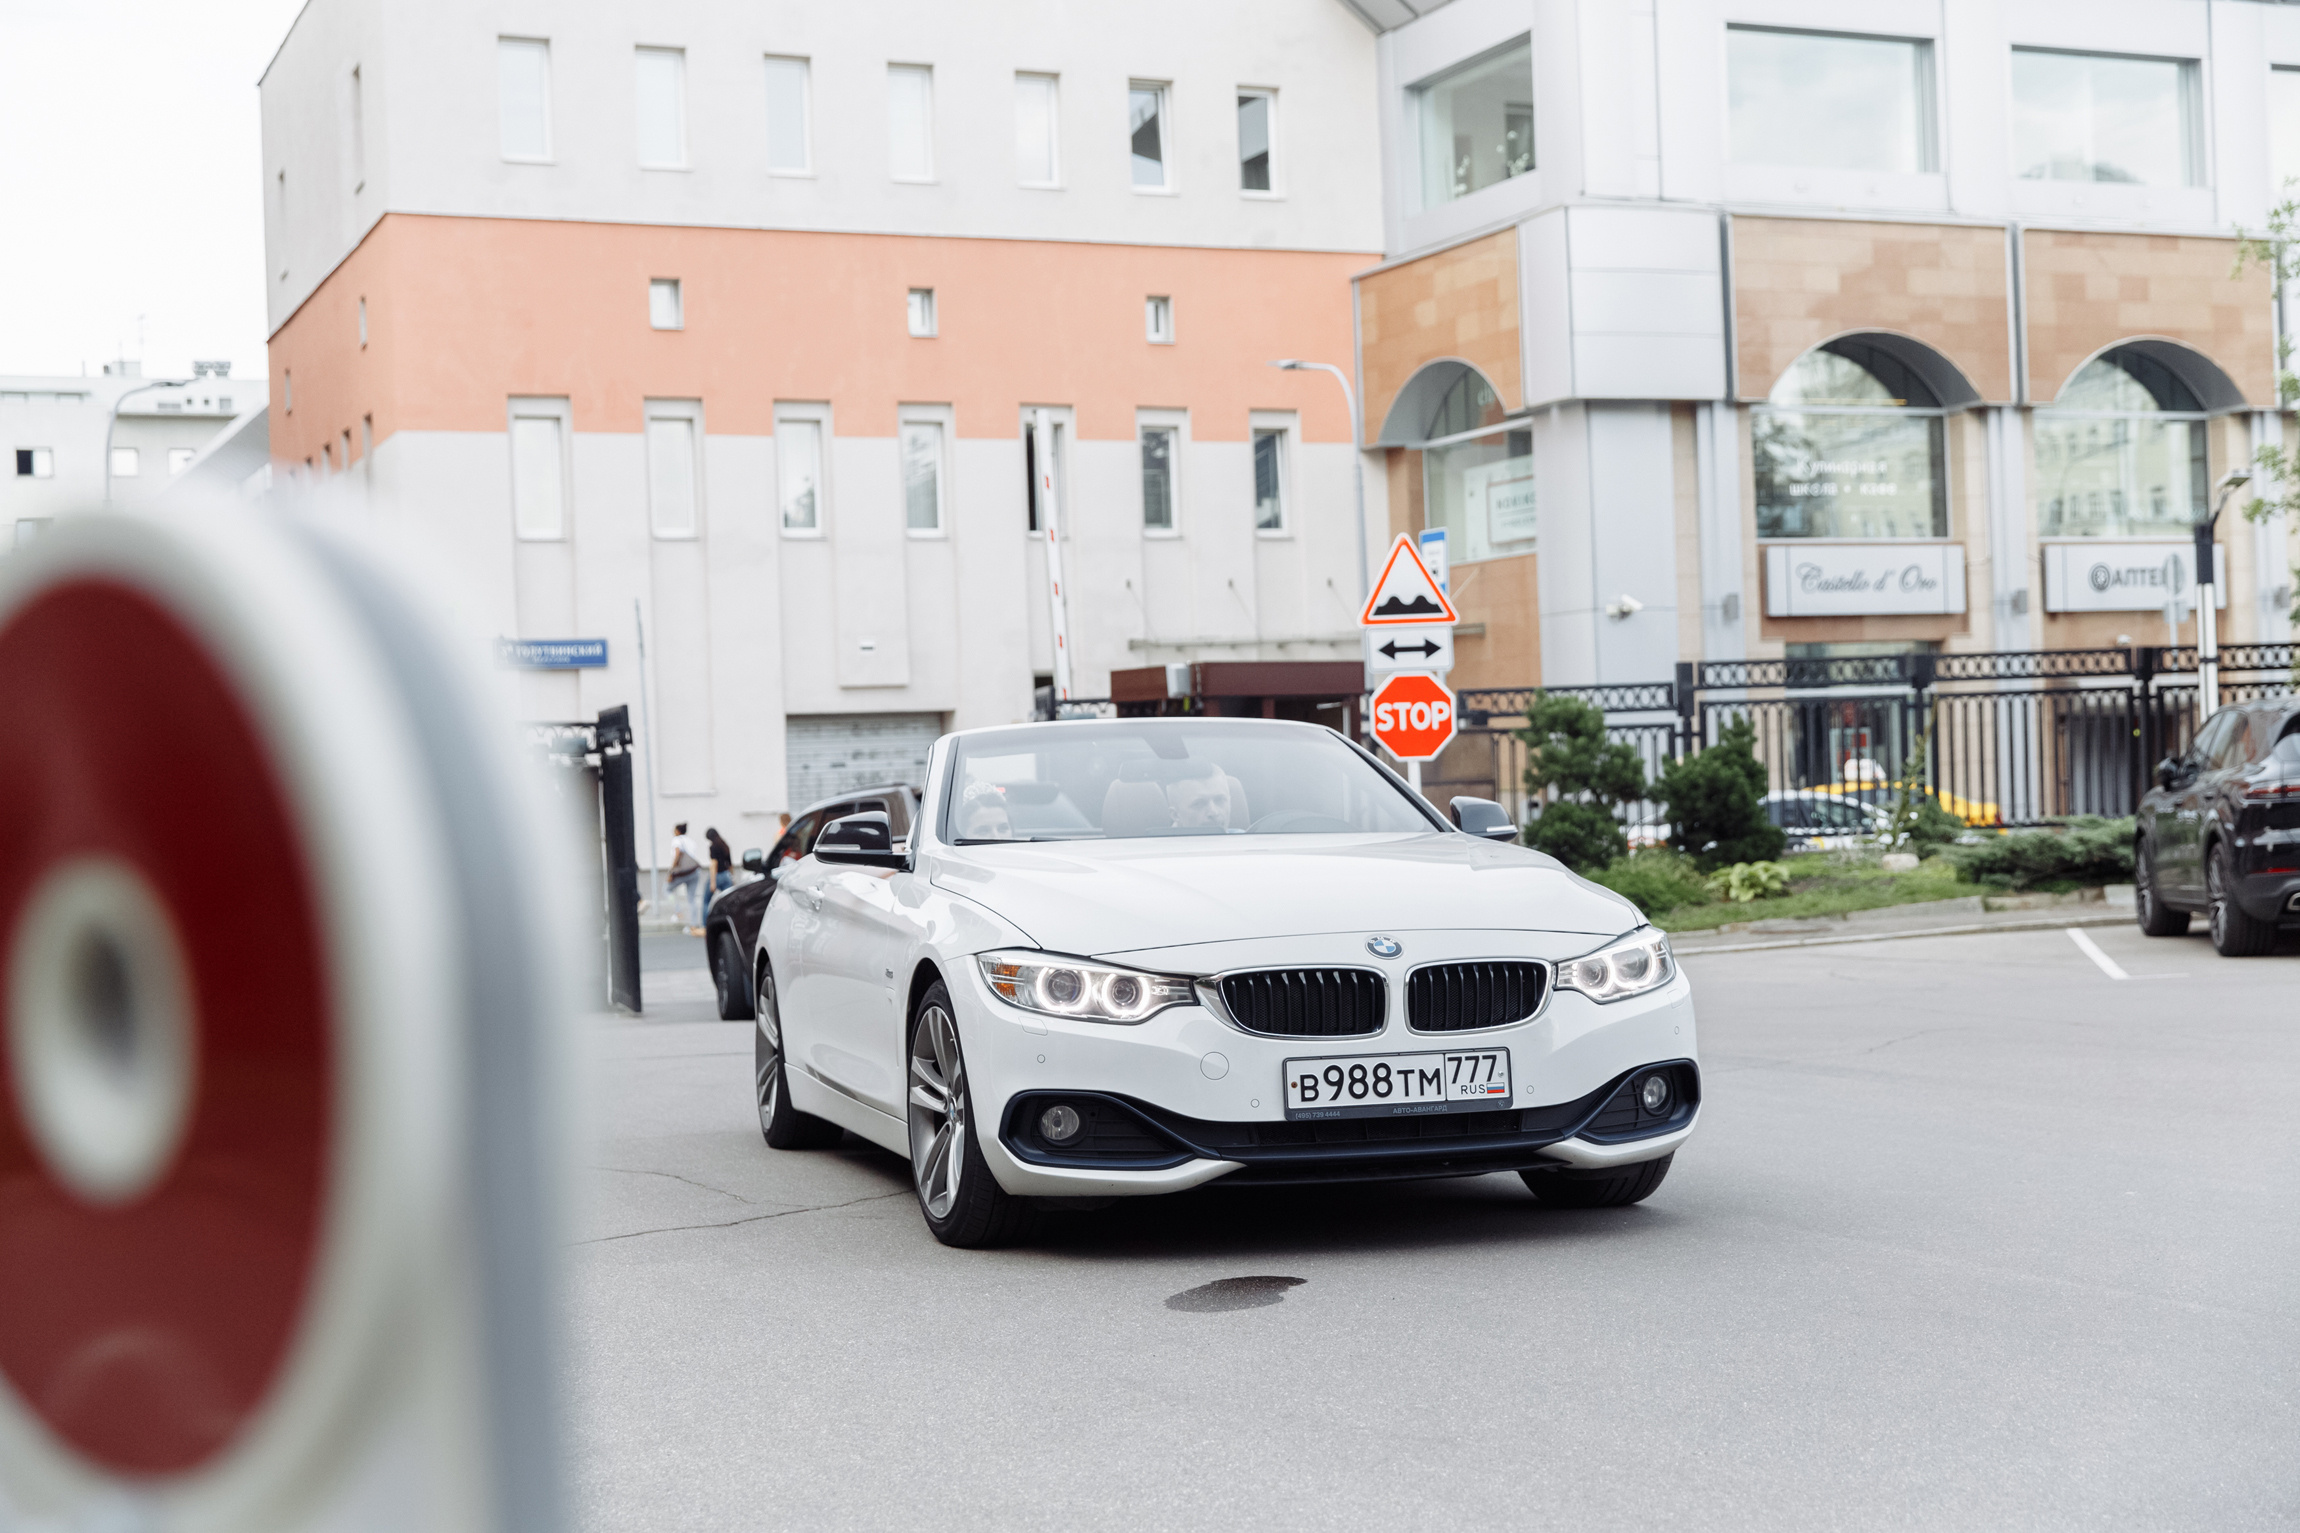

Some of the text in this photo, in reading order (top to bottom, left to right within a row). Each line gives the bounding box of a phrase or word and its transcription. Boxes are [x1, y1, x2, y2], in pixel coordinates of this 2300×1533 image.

[1376, 701, 1450, 732] STOP
[1300, 1054, 1497, 1102] В988ТМ 777
[1461, 1084, 1486, 1095] RUS
[1392, 1104, 1448, 1114] АВТО-АВАНГАРД
[1295, 1112, 1312, 1120] (495)
[1325, 1110, 1341, 1118] 4444
